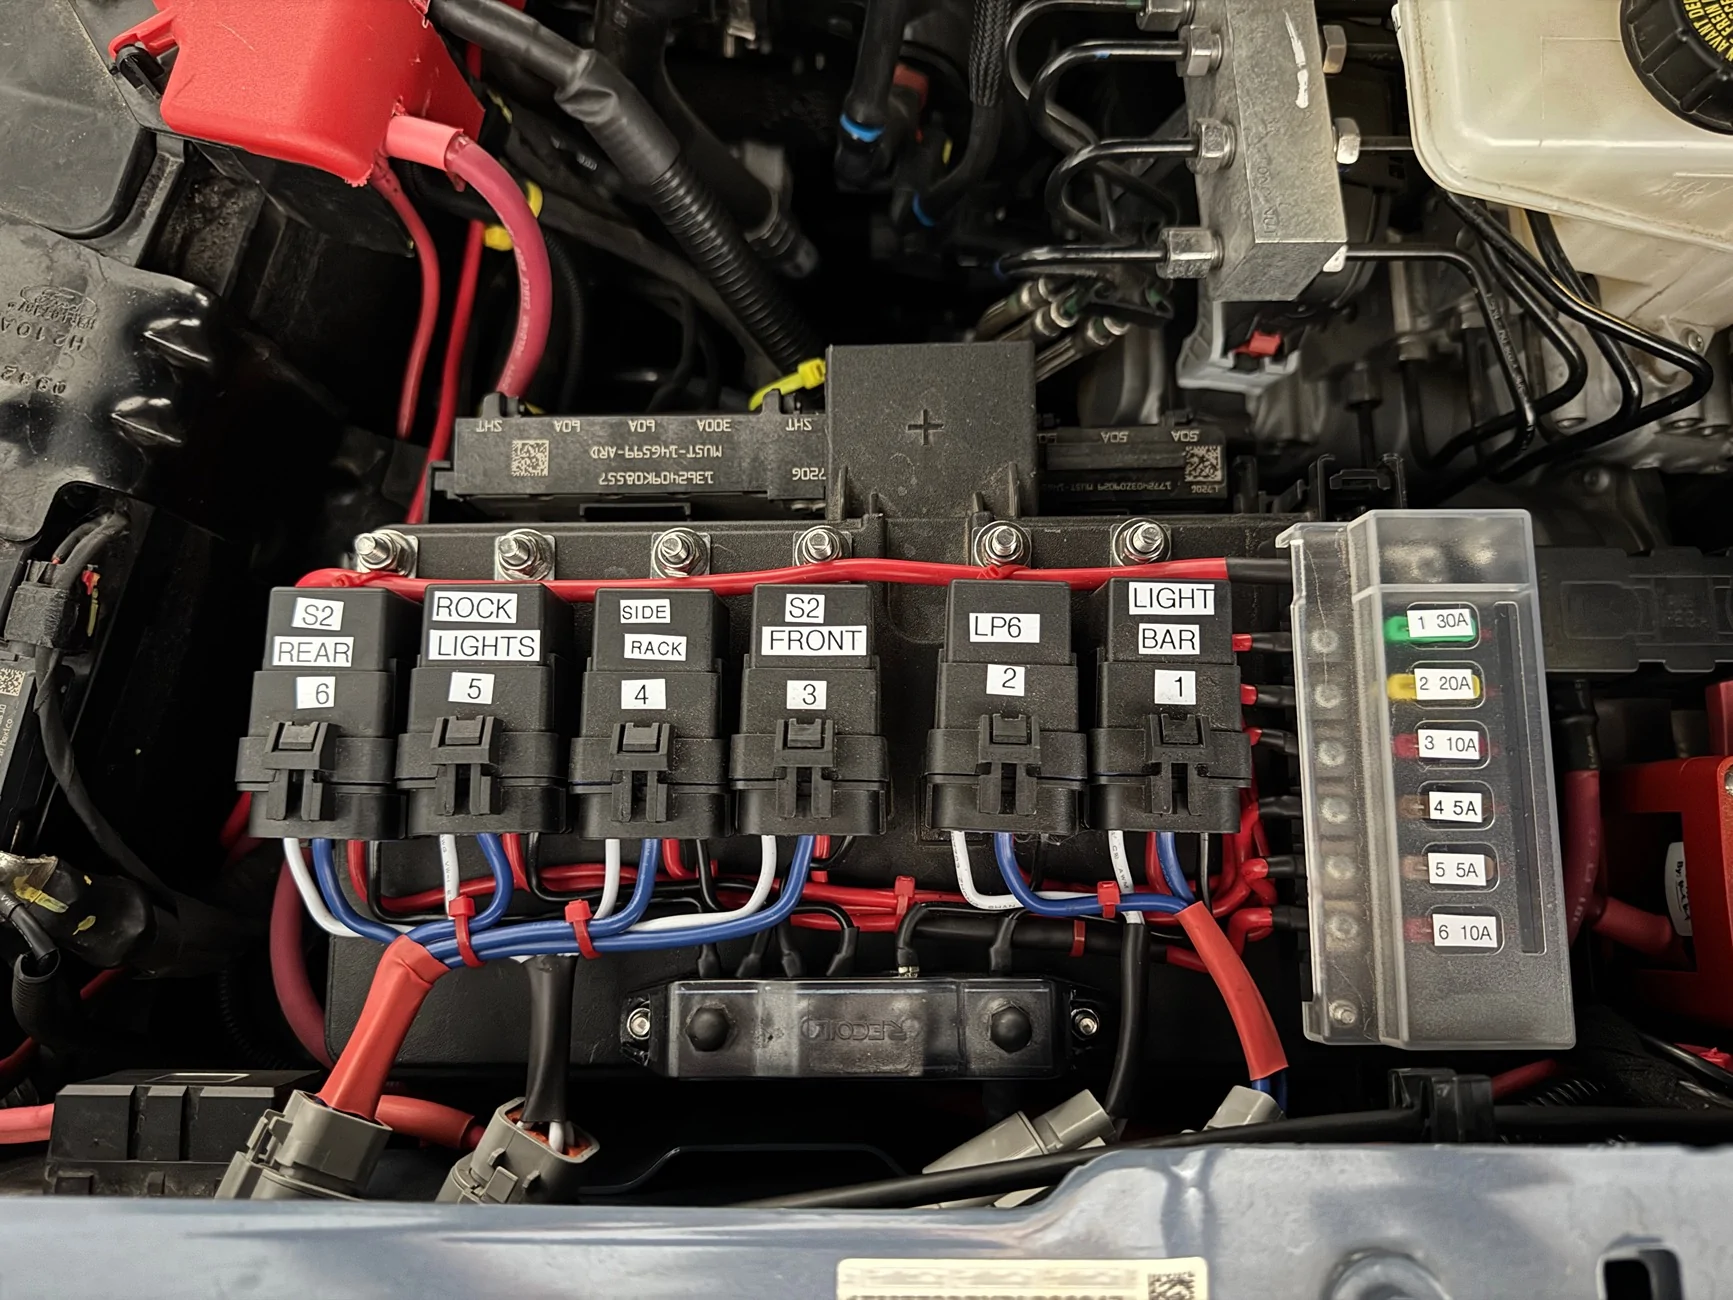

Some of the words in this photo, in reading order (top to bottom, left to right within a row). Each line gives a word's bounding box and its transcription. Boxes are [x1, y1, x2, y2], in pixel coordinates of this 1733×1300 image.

[476, 418, 502, 431] SHT
[554, 418, 580, 431] 60A
[628, 418, 655, 431] 60A
[697, 418, 732, 431] 300A
[785, 418, 812, 431] SHT
[1100, 430, 1130, 444] 50A
[1170, 429, 1200, 442] 50A
[436, 596, 513, 619] ROCK
[789, 597, 820, 619] S2
[1133, 587, 1214, 610] LIGHT
[302, 604, 335, 627] S2
[622, 605, 667, 620] SIDE
[1418, 616, 1426, 630] 1
[1436, 612, 1469, 629] 30A
[974, 615, 1022, 638] LP6
[438, 635, 536, 657] LIGHTS
[631, 640, 683, 657] RACK
[770, 630, 862, 651] FRONT
[1142, 628, 1196, 650] BAR
[277, 641, 351, 663] REAR
[467, 678, 482, 699] 5
[1001, 667, 1016, 689] 2
[1174, 676, 1184, 698] 1
[1419, 676, 1430, 691] 2
[1439, 676, 1471, 691] 20A
[315, 683, 330, 705] 6
[634, 684, 649, 704] 4
[802, 684, 817, 705] 3
[1424, 735, 1435, 750] 3
[1446, 737, 1478, 752] 10A
[1433, 800, 1445, 815] 4
[1453, 800, 1478, 816] 5A
[1435, 861, 1446, 878] 5
[1455, 862, 1479, 878] 5A
[1438, 924, 1449, 940] 6
[1461, 925, 1493, 941] 10A
